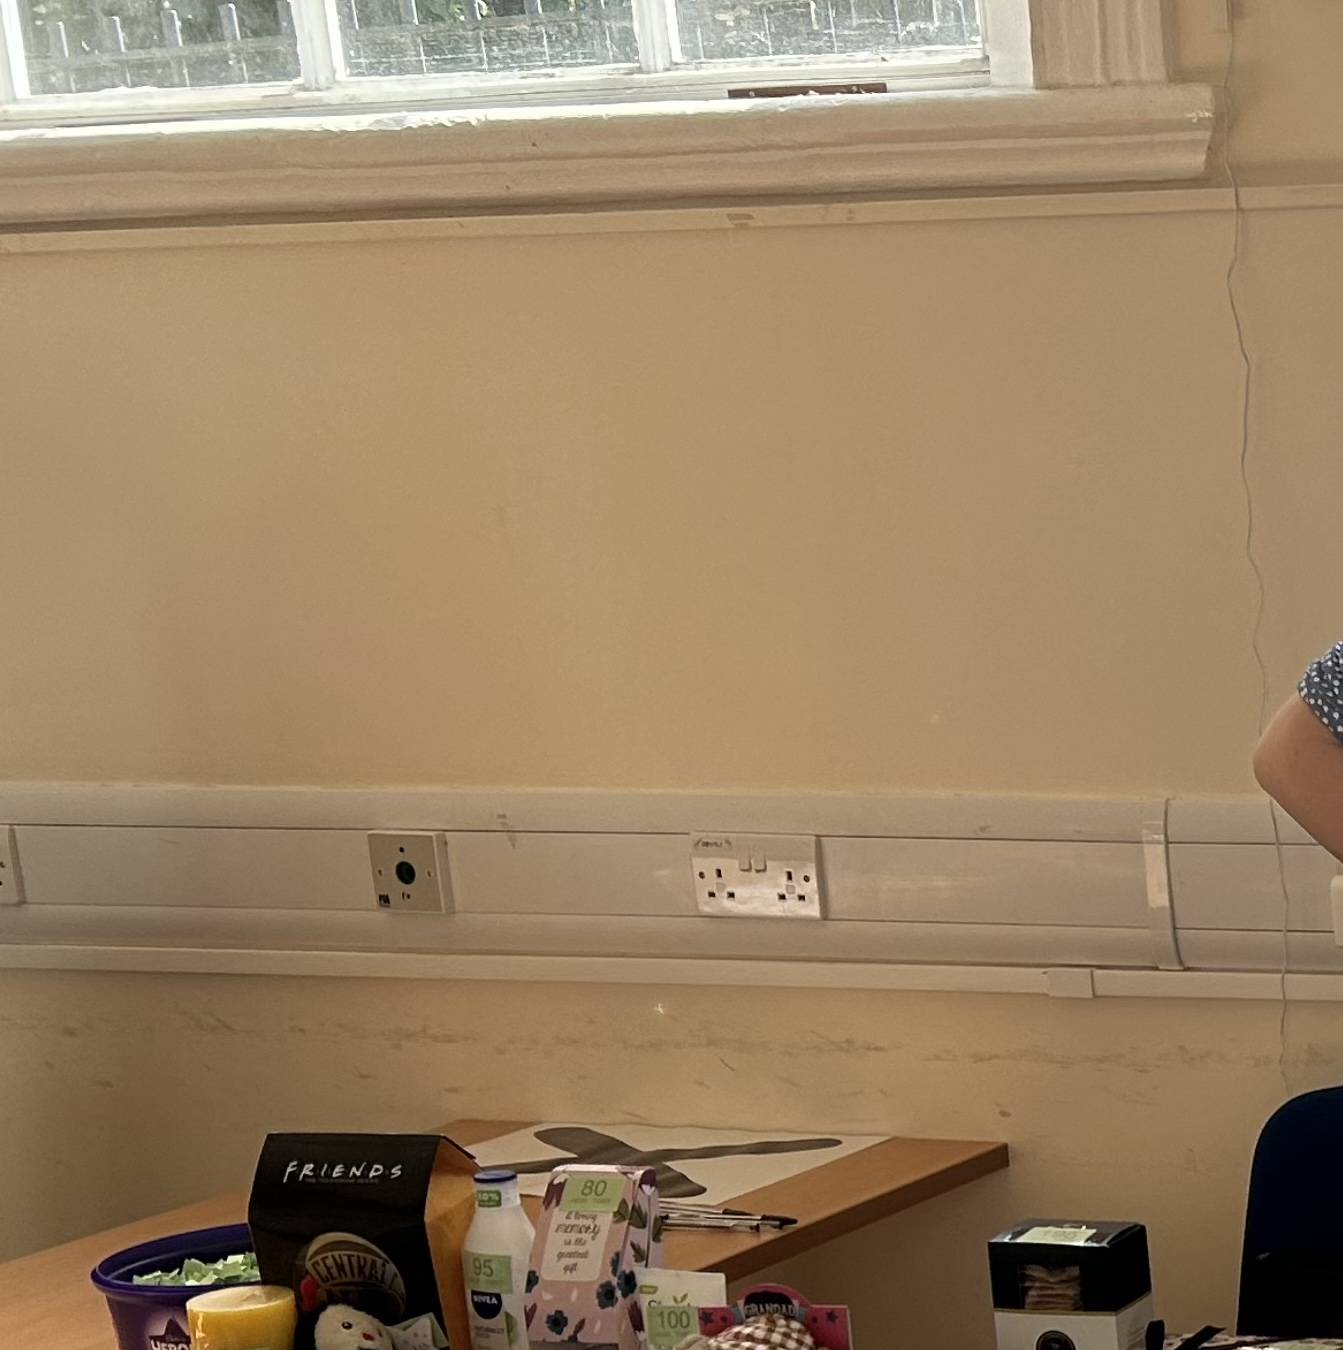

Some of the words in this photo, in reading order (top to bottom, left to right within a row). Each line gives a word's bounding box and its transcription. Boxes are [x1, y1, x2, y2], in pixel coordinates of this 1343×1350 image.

[580, 1180, 607, 1197] 80
[472, 1257, 494, 1278] 95
[472, 1294, 499, 1306] NIVEA
[744, 1302, 797, 1317] GRANDAD
[656, 1310, 691, 1329] 100
